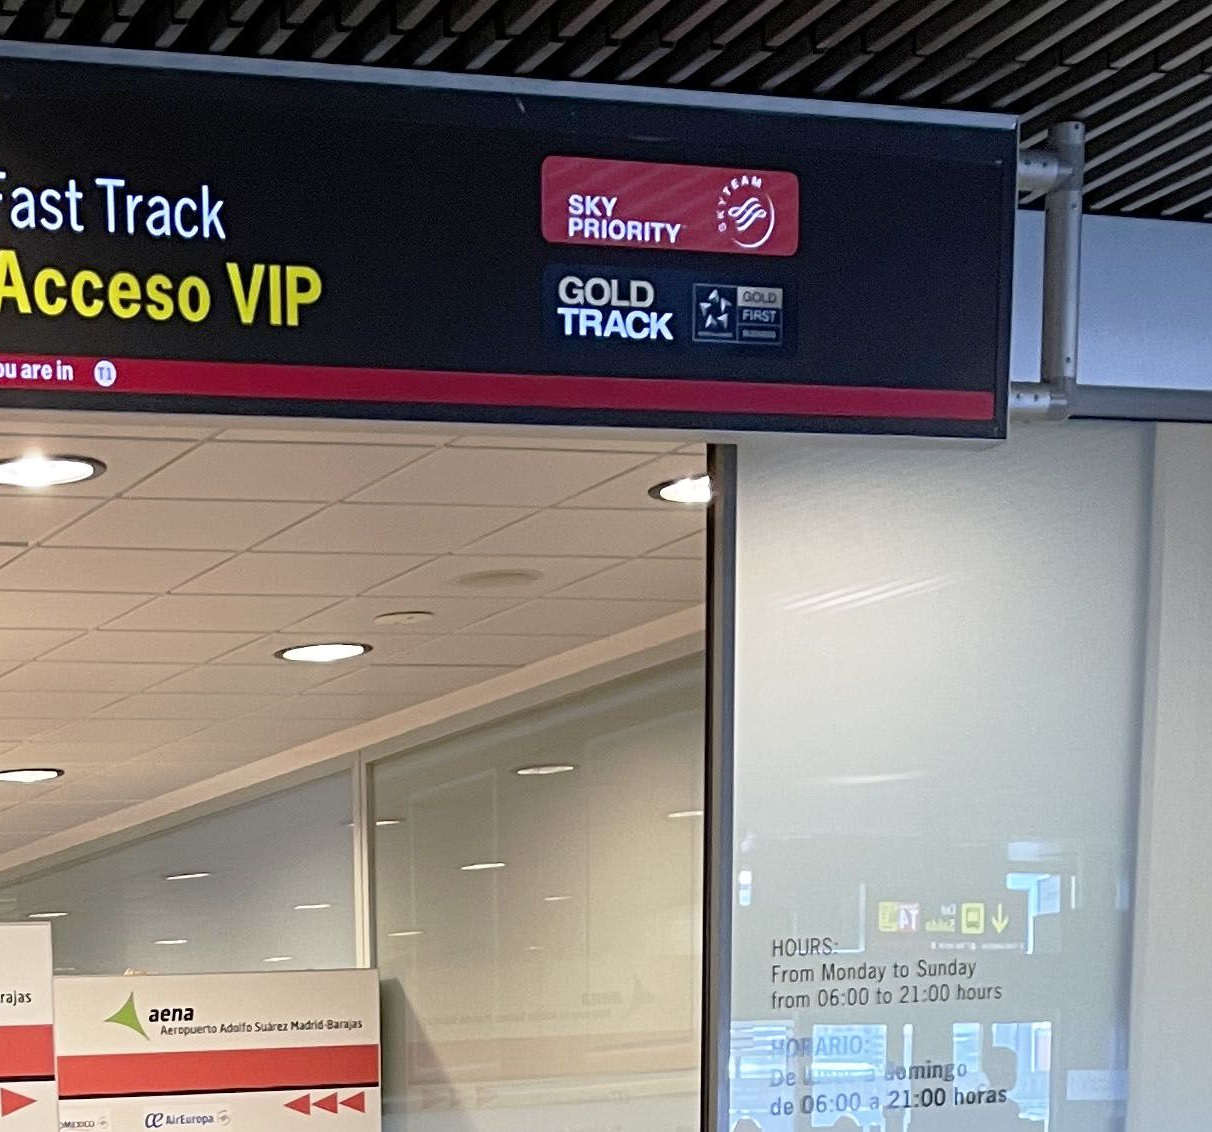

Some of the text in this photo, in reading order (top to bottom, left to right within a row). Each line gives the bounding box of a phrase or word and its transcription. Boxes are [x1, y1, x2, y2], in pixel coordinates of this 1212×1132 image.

[96, 177, 226, 240] Track
[568, 194, 617, 217] SKY
[568, 217, 681, 244] PRIORITY
[226, 261, 323, 326] VIP
[558, 275, 655, 308] GOLD
[742, 291, 777, 304] GOLD
[557, 307, 674, 340] TRACK
[742, 308, 776, 322] FIRST
[20, 361, 52, 381] are
[56, 359, 74, 381] in
[772, 938, 839, 957] HOURS:
[772, 959, 977, 983] From Monday to Sunday
[771, 982, 1002, 1009] from 06:00 to 21:00 hours
[148, 1006, 194, 1023] aena
[161, 1024, 217, 1036] Aeropuerto
[220, 1022, 253, 1034] Adolfo
[770, 1070, 796, 1087] De
[770, 1086, 1007, 1116] de 06:00 a 21:00 horas
[166, 1114, 214, 1126] AirEuropa
